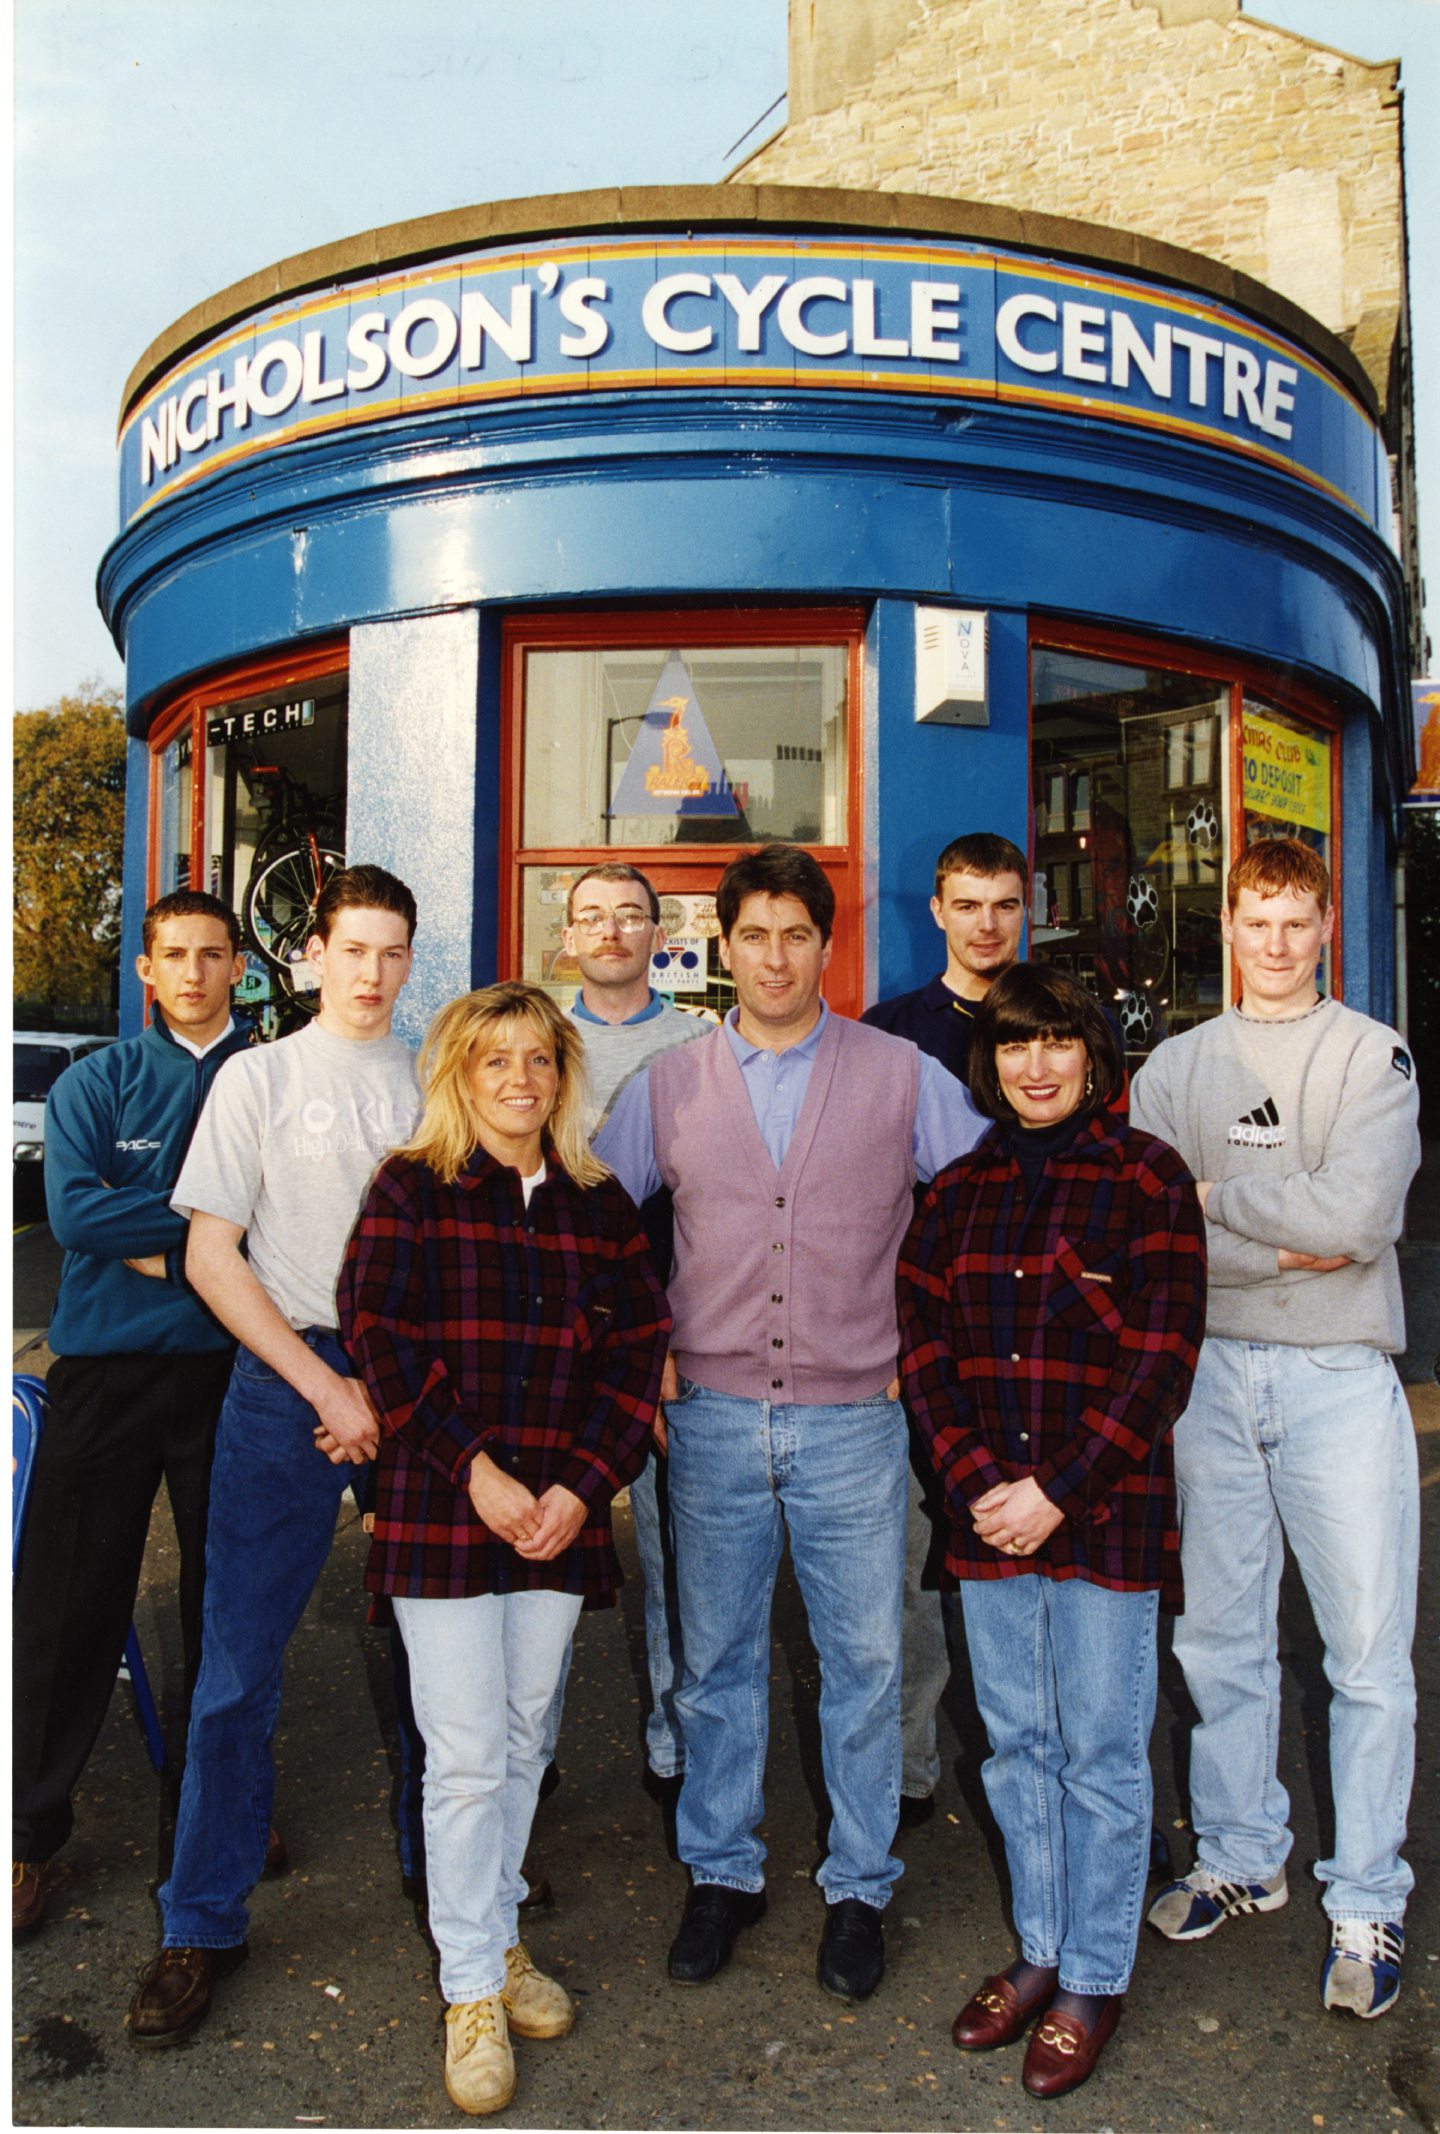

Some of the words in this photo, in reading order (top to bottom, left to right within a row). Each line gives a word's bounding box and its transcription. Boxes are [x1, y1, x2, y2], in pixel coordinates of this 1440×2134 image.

[141, 261, 609, 485] NICHOLSON'S
[641, 272, 961, 362] CYCLE
[995, 293, 1299, 441] CENTRE
[957, 620, 973, 672] NOVA
[1276, 741, 1302, 763] CLUB
[1261, 762, 1302, 796] DEPOSIT
[651, 971, 699, 979] BRITISH
[115, 1138, 162, 1152] PACE
[293, 1134, 332, 1162] High
[1226, 1138, 1286, 1150] EQUIPMEN
